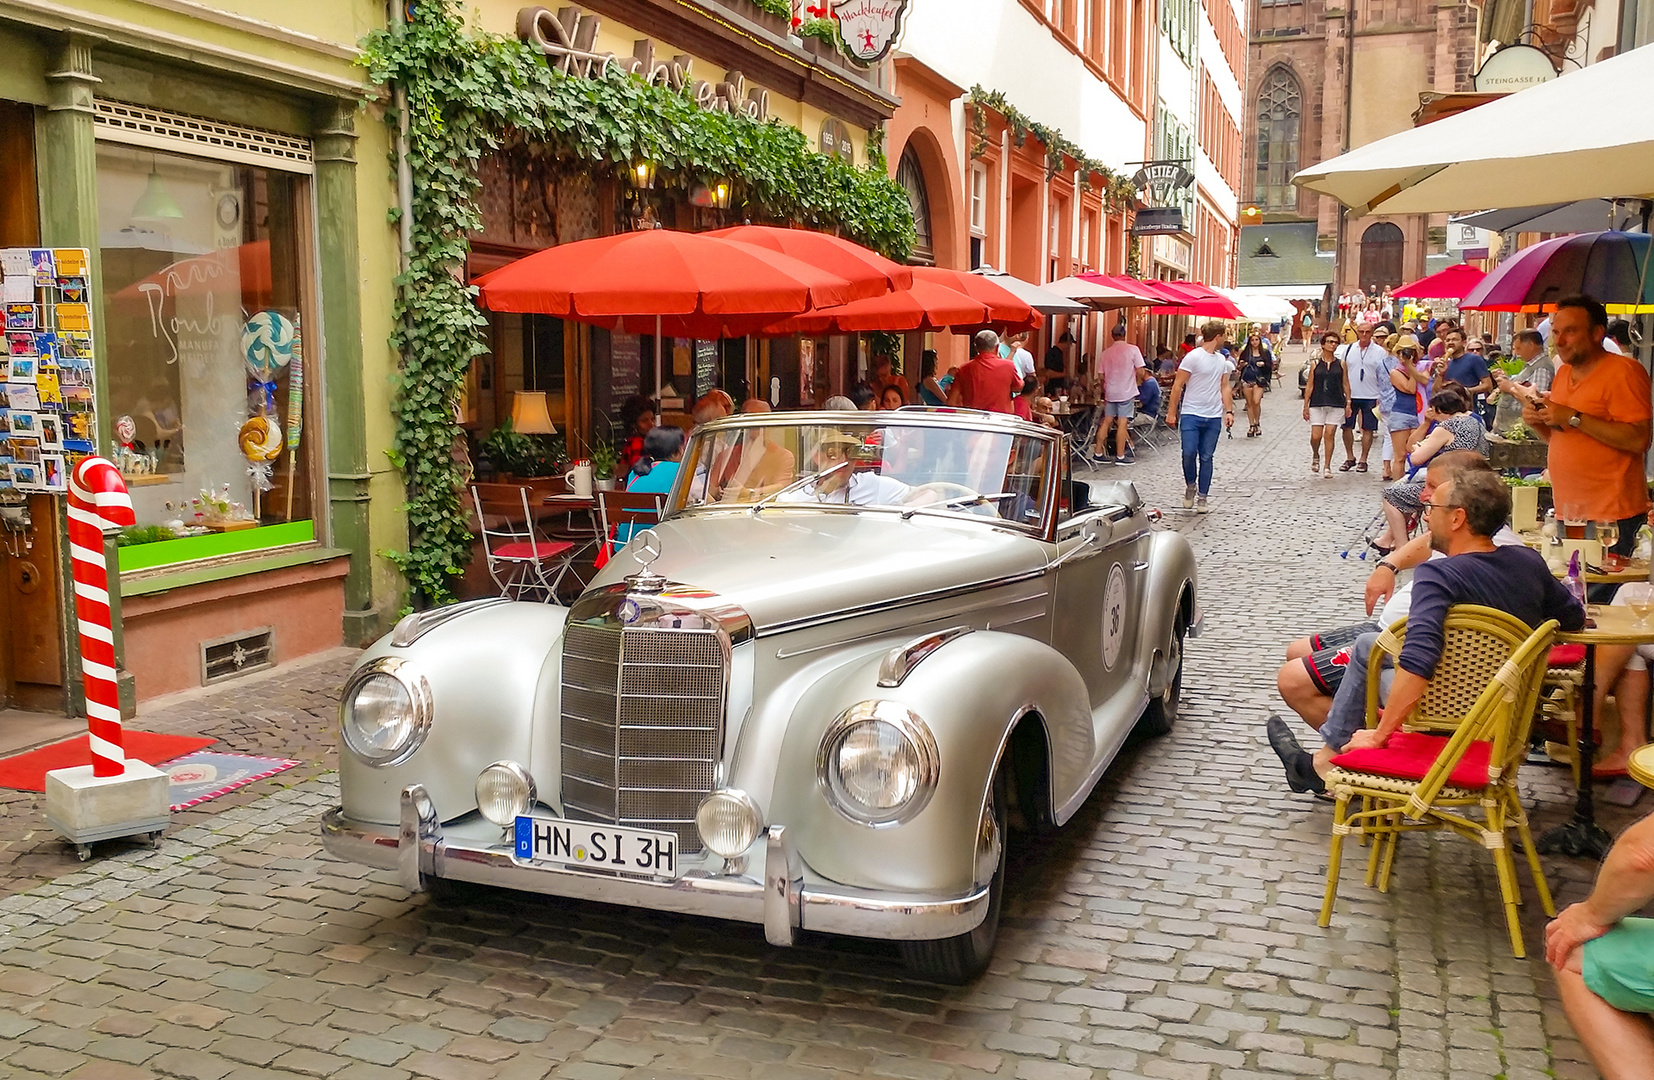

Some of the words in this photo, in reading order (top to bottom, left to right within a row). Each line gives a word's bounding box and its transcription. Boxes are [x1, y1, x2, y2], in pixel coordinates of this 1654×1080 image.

[841, 0, 896, 22] Hackteufel
[1485, 76, 1534, 85] STEINGASSE
[1143, 165, 1180, 180] VETTER
[1110, 604, 1120, 637] 36
[521, 841, 528, 851] D
[534, 824, 571, 857] HN
[590, 832, 626, 865] SI
[635, 837, 673, 871] 3H
